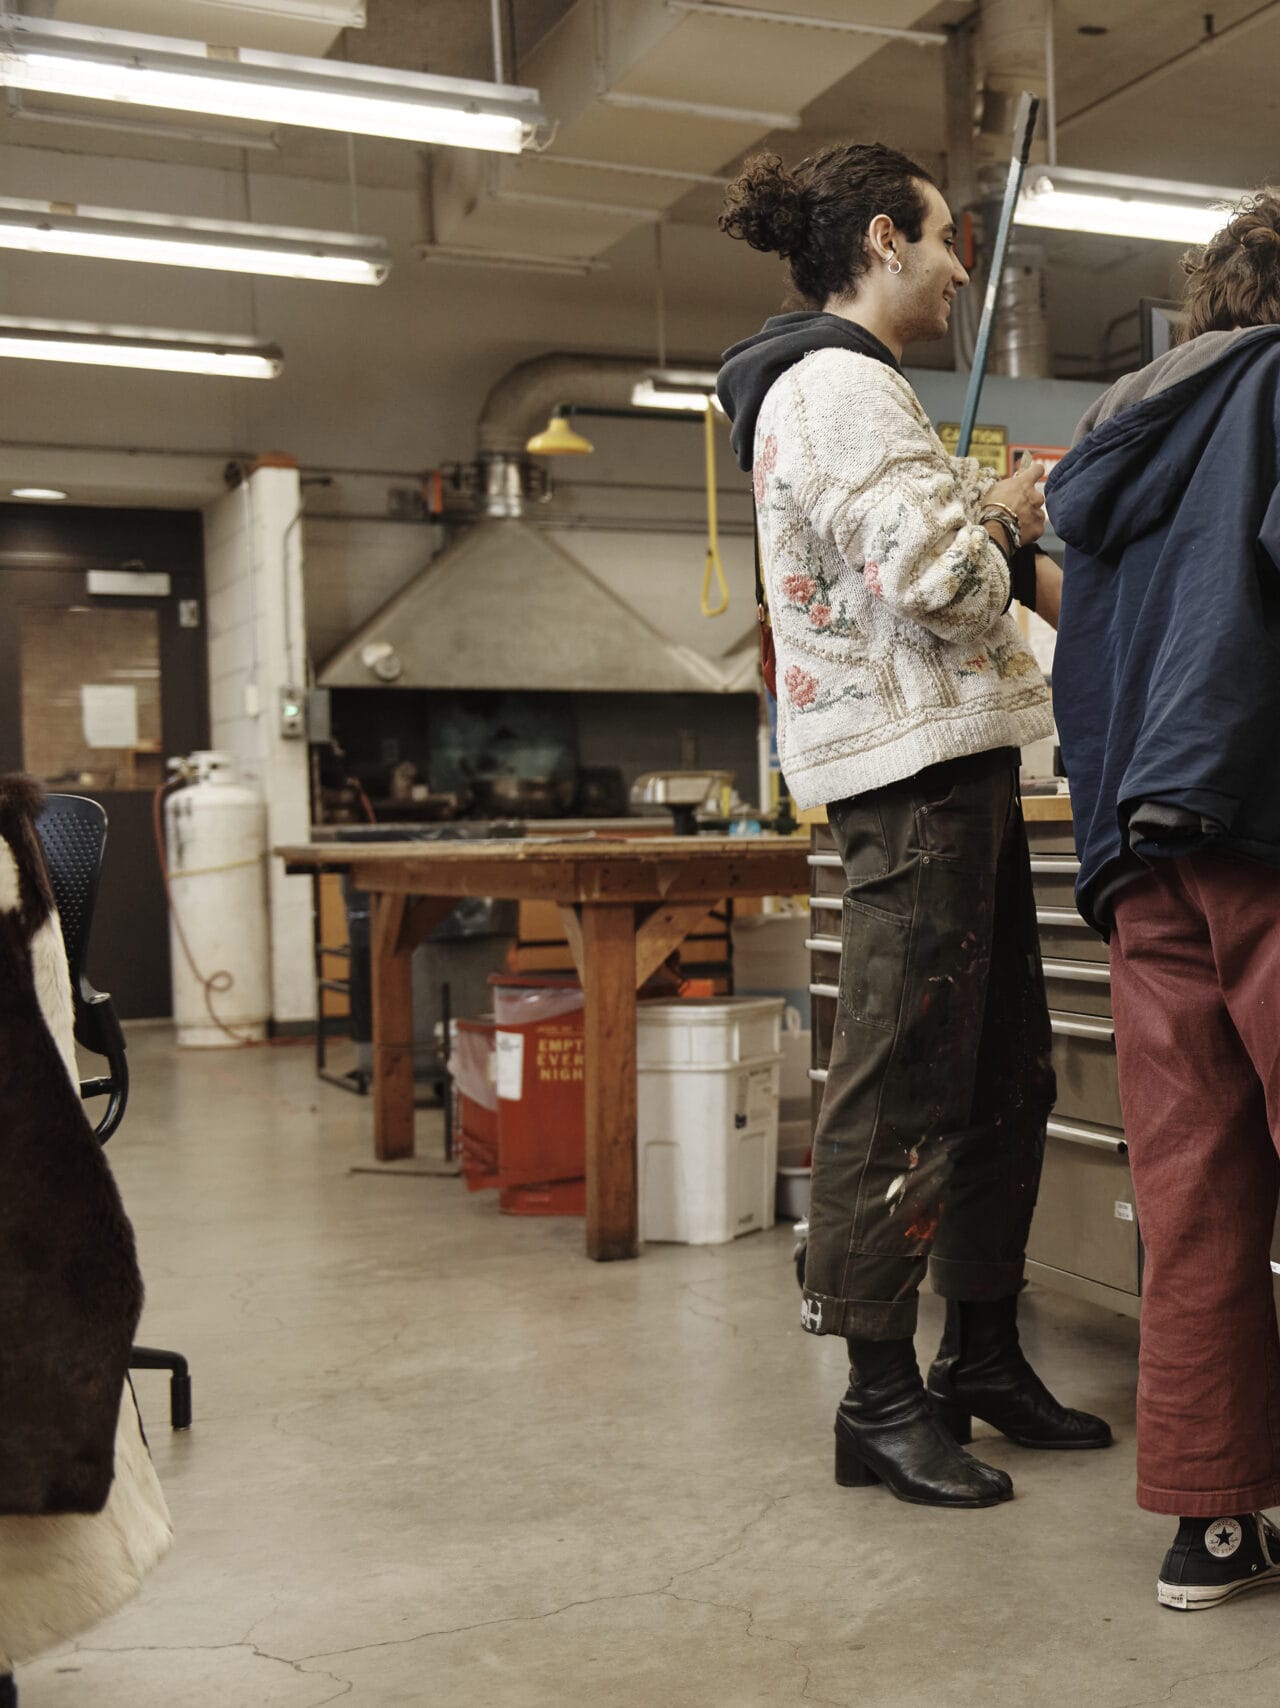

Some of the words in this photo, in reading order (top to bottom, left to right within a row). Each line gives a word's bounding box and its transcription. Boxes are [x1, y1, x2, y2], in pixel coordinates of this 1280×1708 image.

[538, 1039, 583, 1052] EMPT
[536, 1053, 583, 1067] EVER
[540, 1067, 583, 1081] NIGH
